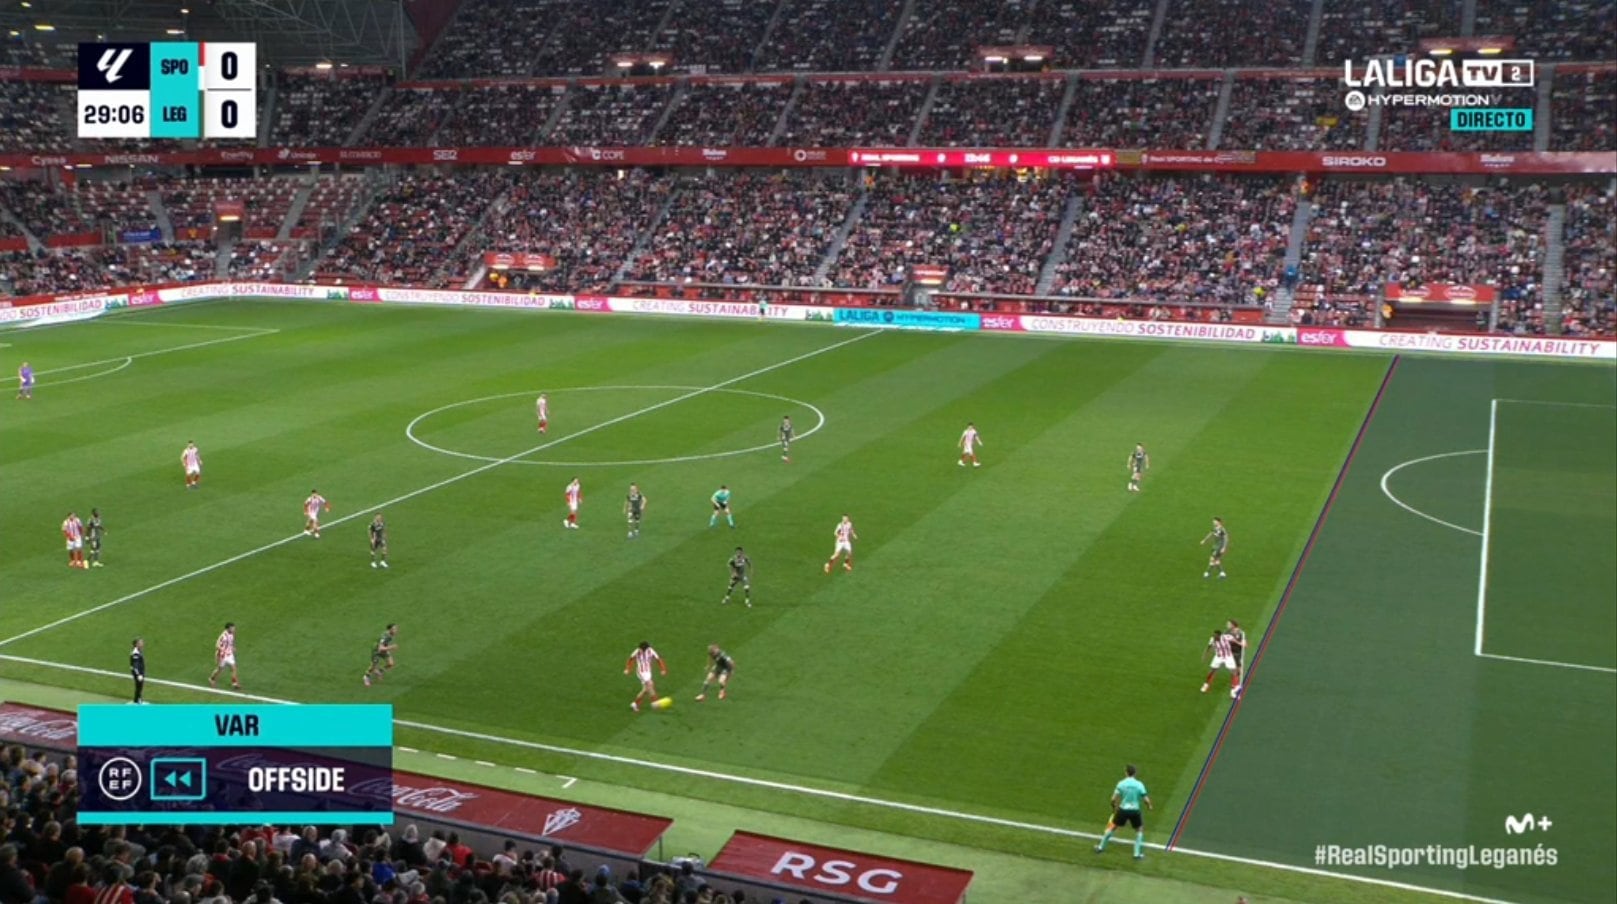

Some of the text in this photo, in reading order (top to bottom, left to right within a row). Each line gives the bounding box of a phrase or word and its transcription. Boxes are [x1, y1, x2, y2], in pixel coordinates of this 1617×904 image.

[104, 155, 159, 165] NISSAN
[1321, 155, 1387, 167] SIROKO
[232, 284, 314, 297] SUSTAINABILITY
[462, 294, 546, 307] SOSTENIBILIDAD
[632, 302, 686, 312] CREATING
[20, 300, 101, 319] SOSTENIBILIDAD
[839, 309, 880, 323] LALIGA
[983, 317, 1015, 328] esfer
[1031, 318, 1135, 333] CONSTRUYENDO
[1138, 323, 1256, 340] SOSTENIBILIDAD
[1301, 330, 1337, 344] esfer
[1379, 334, 1602, 355] CREATING SUSTAINABILITY
[770, 851, 902, 894] RSG
